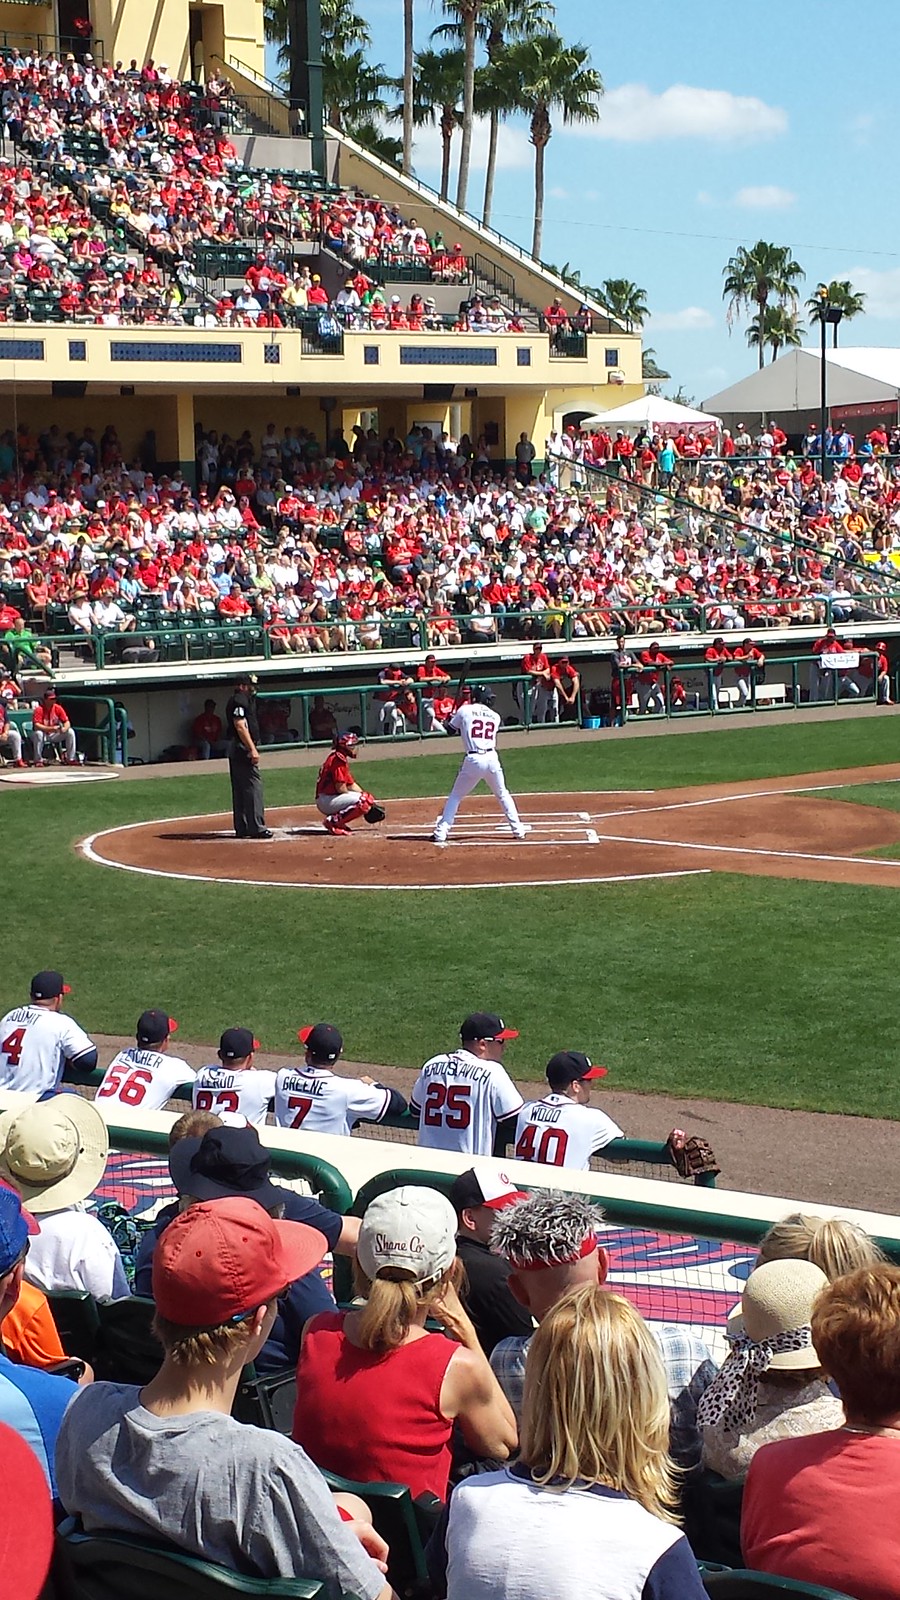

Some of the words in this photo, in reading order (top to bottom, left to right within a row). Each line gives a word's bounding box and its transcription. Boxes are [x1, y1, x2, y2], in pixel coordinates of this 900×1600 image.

[471, 719, 495, 740] 22
[2, 1028, 26, 1066] 4
[98, 1065, 153, 1107] 56
[282, 1076, 328, 1096] GREENE
[288, 1096, 314, 1130] 7
[425, 1082, 471, 1129] 25
[530, 1106, 562, 1123] WOOD
[516, 1125, 569, 1167] 40
[375, 1233, 408, 1253] Shane
